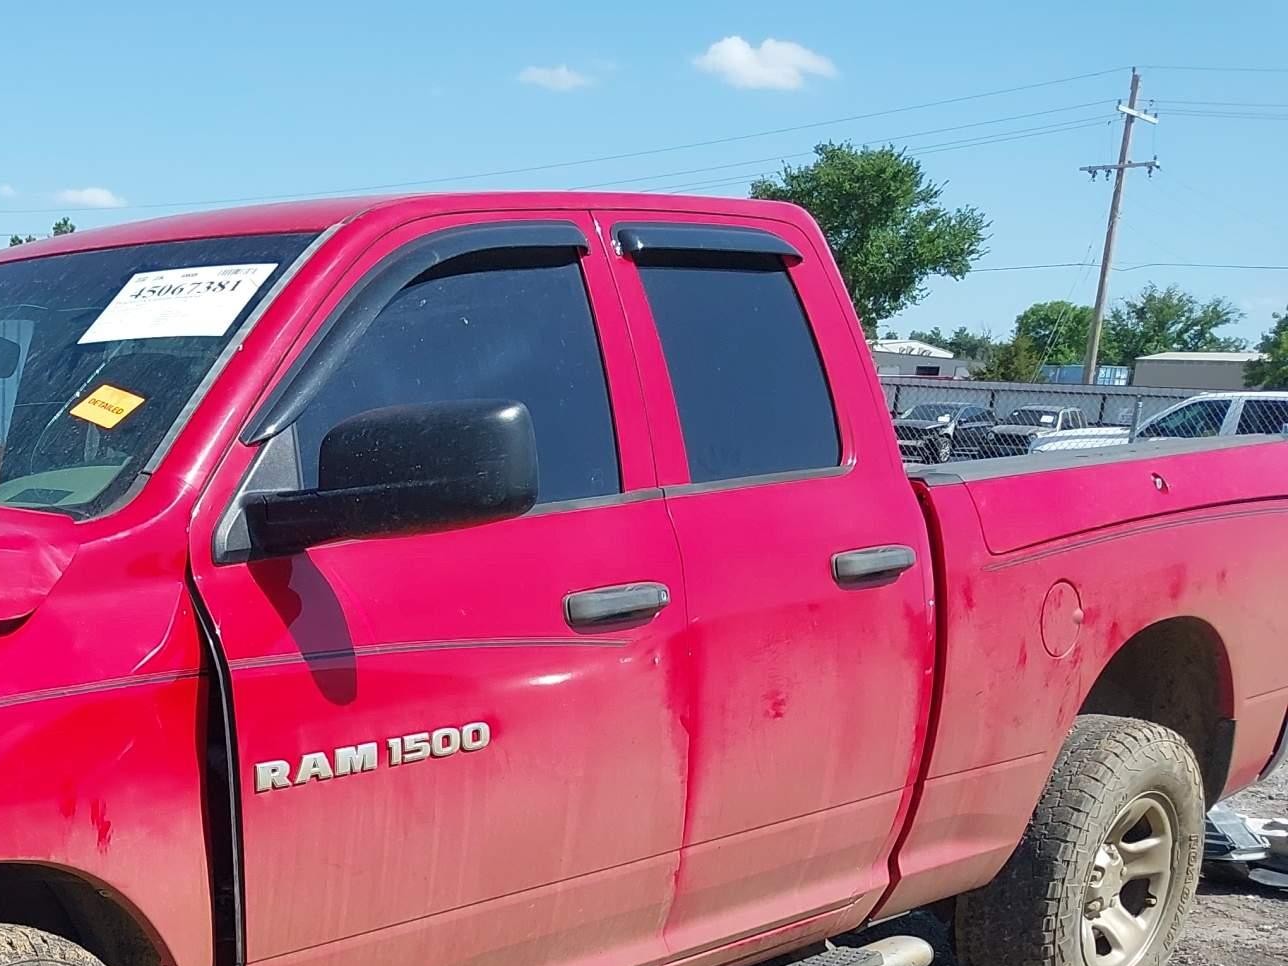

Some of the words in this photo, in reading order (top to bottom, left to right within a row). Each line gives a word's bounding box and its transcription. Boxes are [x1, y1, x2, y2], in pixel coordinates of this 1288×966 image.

[130, 279, 242, 299] 45067381
[87, 397, 124, 415] DETAILED
[255, 742, 378, 793] RAM
[388, 722, 491, 766] 1500
